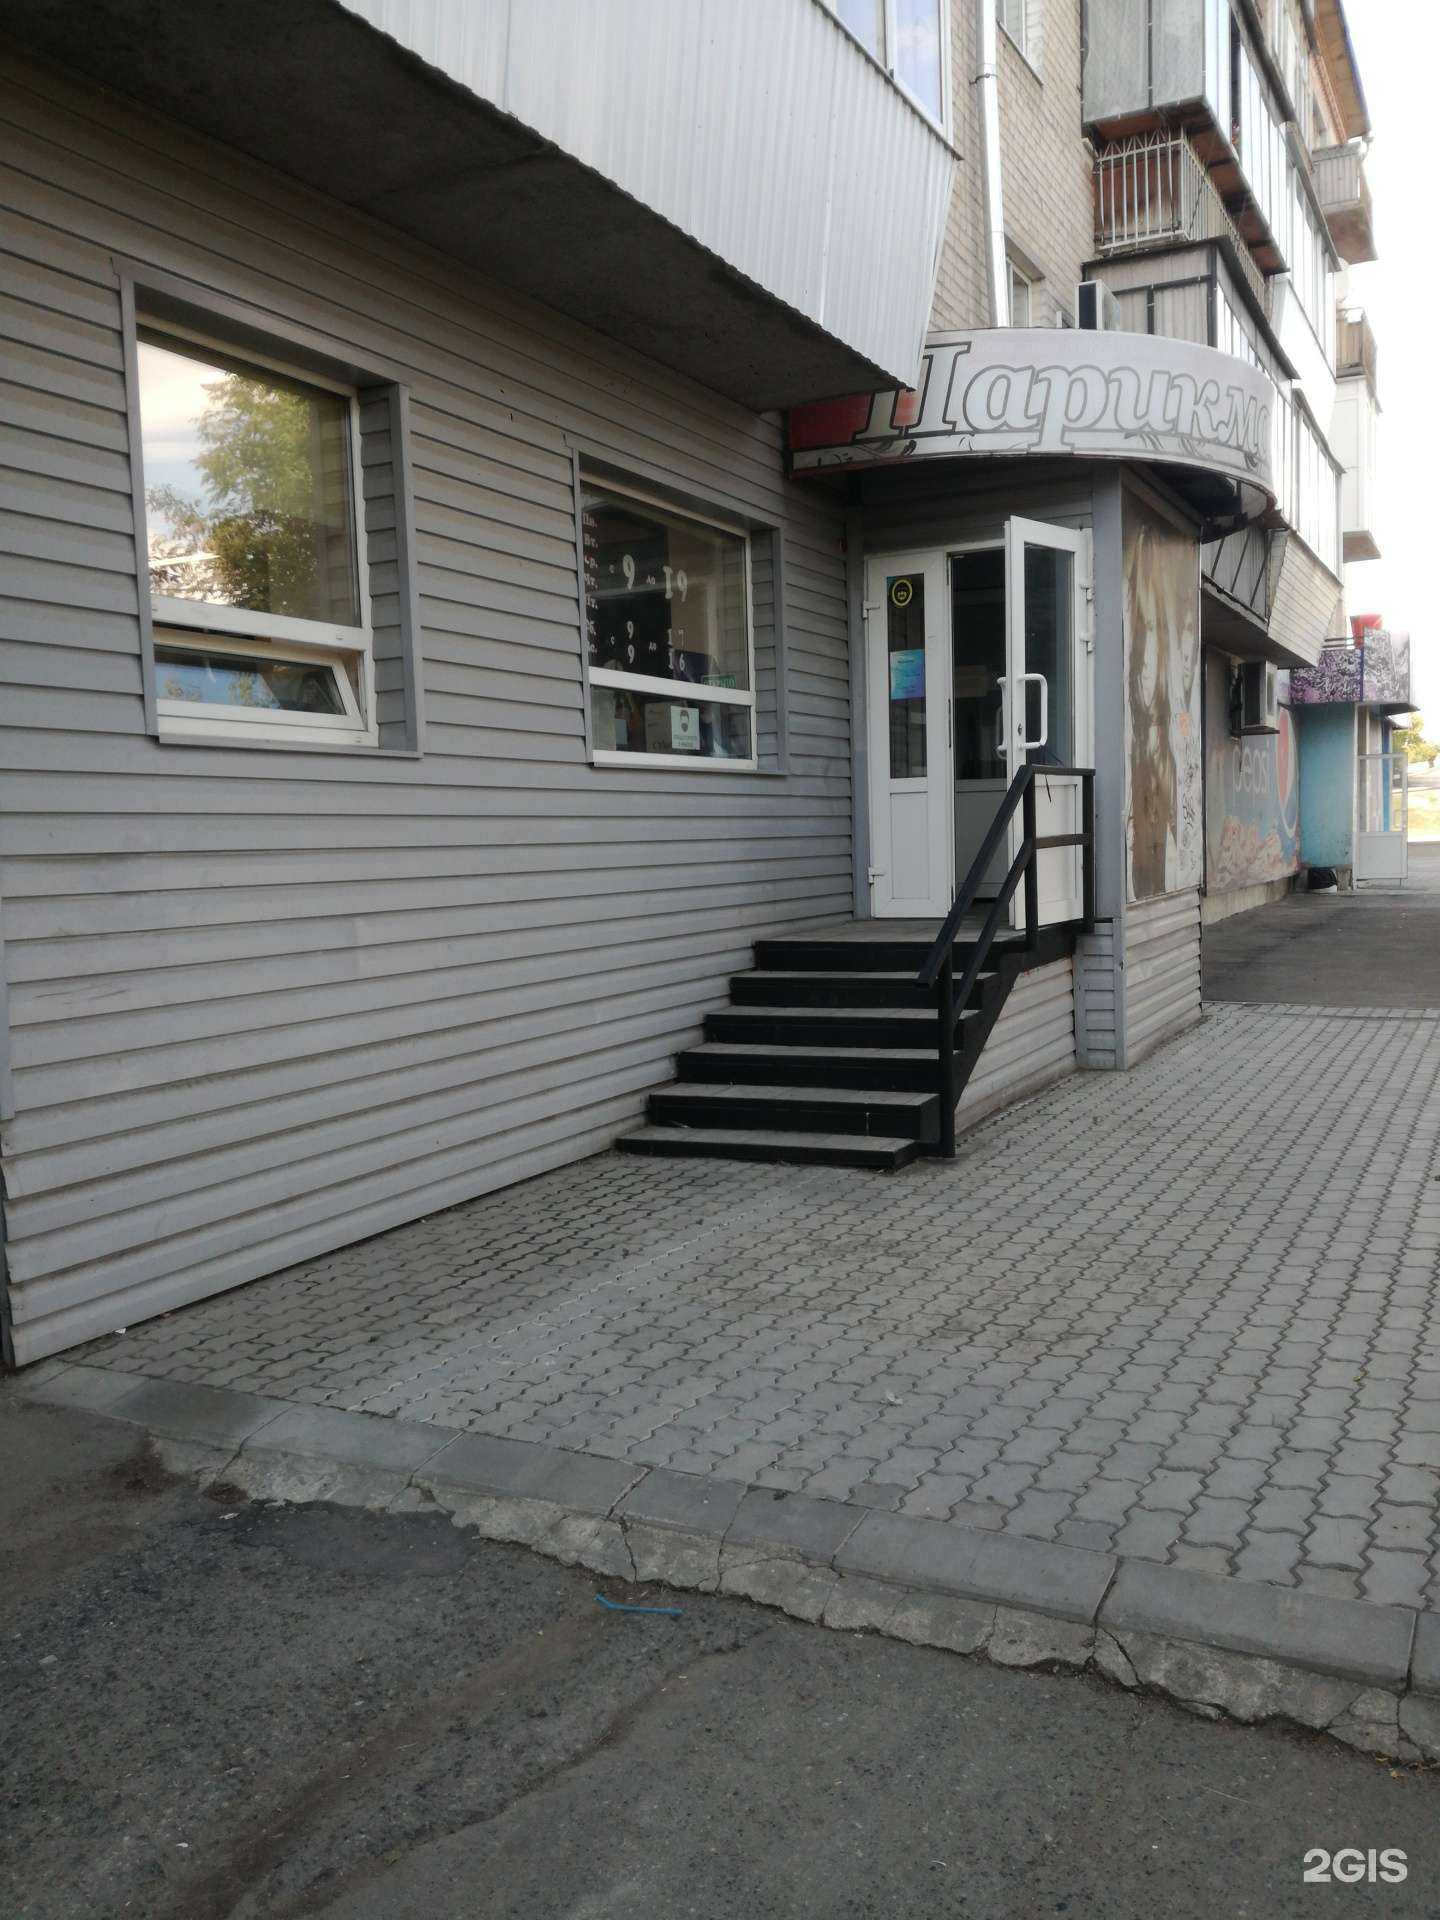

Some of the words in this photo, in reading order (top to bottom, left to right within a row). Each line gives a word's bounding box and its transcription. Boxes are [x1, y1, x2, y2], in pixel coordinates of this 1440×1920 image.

[622, 553, 636, 591] 9
[662, 565, 688, 602] 19
[626, 620, 635, 640] 9
[627, 643, 636, 665] 9
[668, 649, 686, 672] 16
